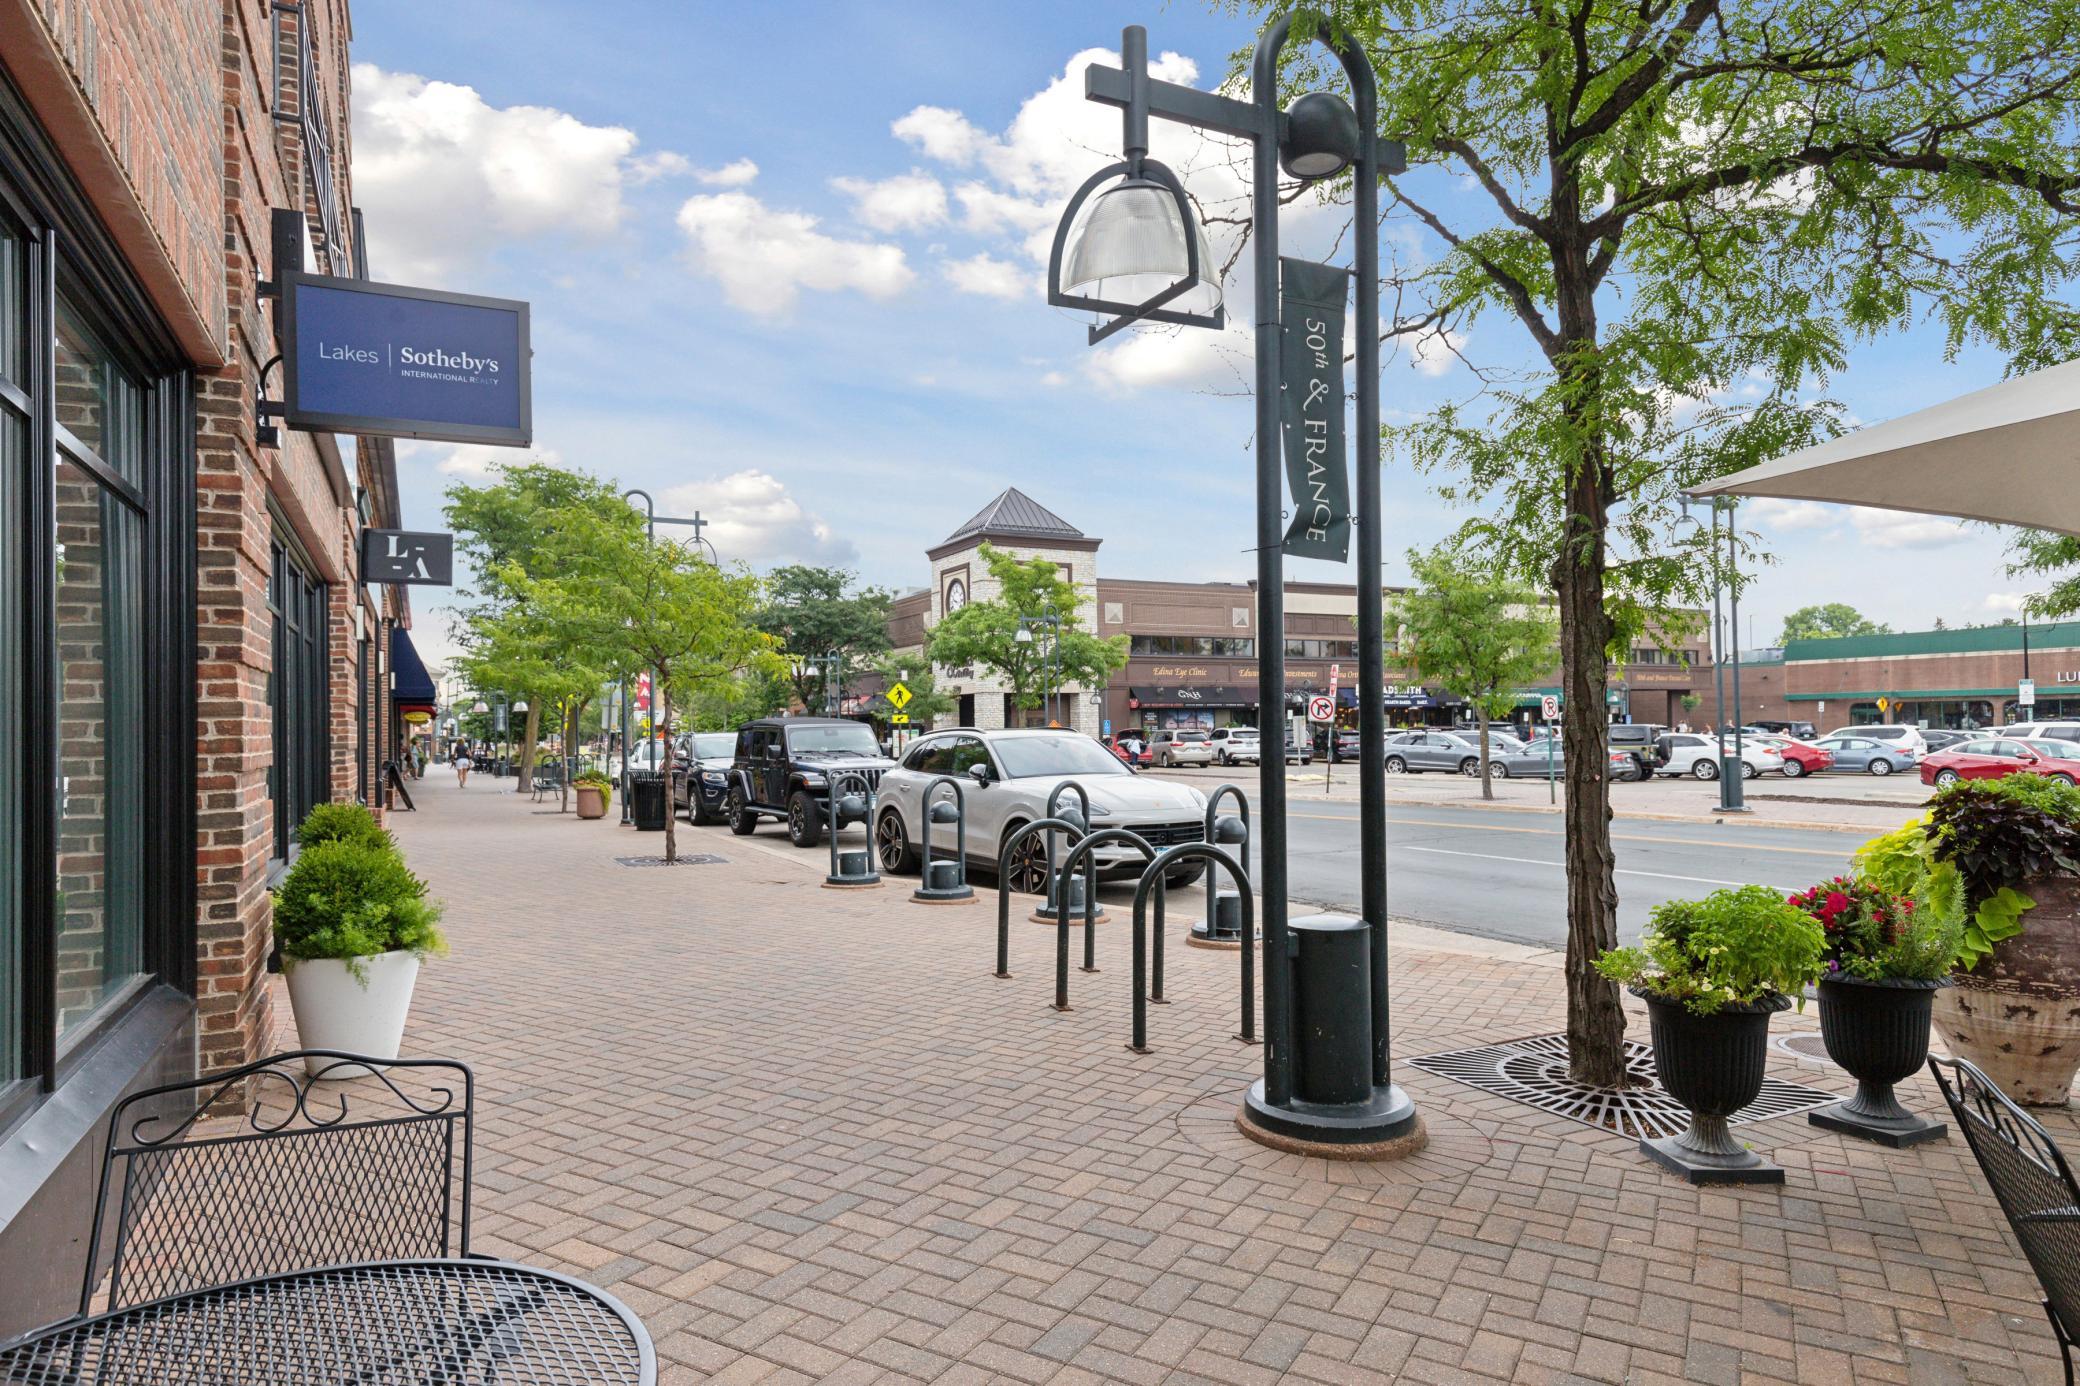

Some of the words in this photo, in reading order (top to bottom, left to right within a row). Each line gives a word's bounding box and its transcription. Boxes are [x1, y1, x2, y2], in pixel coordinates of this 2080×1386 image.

[319, 341, 379, 364] Lakes
[401, 346, 499, 375] Sotheby's
[1306, 318, 1329, 369] 50th
[401, 370, 468, 383] INTERNATIONAL
[1303, 378, 1329, 411] &
[1304, 418, 1332, 543] FRANCE
[1152, 666, 1173, 676] Edina
[1174, 667, 1187, 679] Eye
[1188, 666, 1208, 676] Clinic
